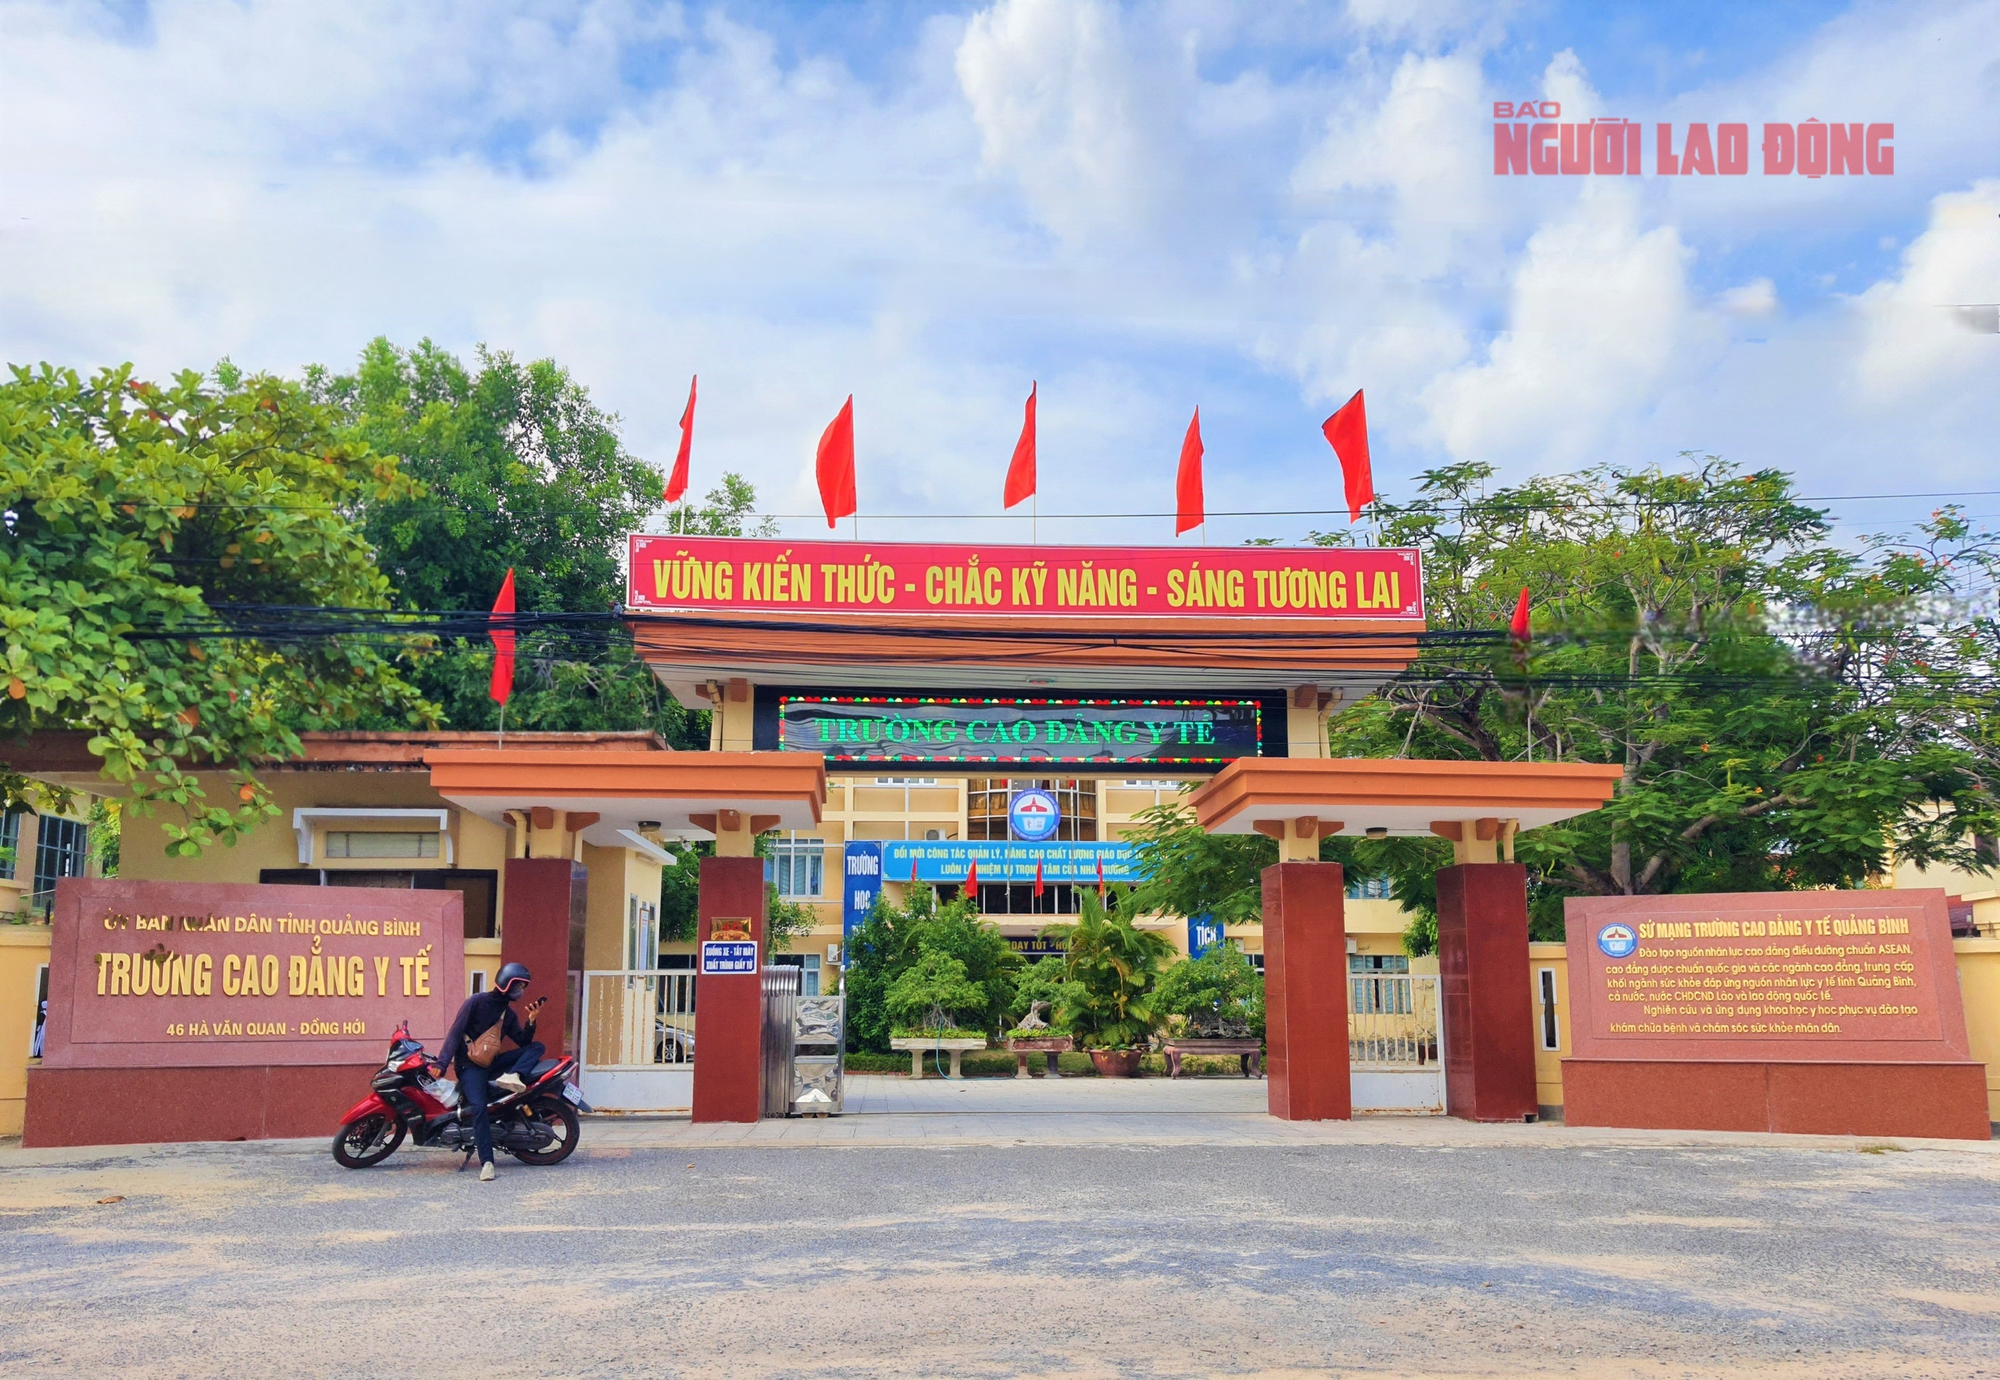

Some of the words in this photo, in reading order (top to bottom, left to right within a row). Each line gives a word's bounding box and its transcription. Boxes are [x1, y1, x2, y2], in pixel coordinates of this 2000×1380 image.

[654, 550, 733, 600] VỮNG
[743, 550, 810, 602] KIẾN
[820, 554, 895, 603] THỨC
[926, 554, 1002, 605] CHẮC
[1012, 561, 1047, 606] KỸ
[1057, 560, 1137, 607] NĂNG
[1167, 563, 1244, 607] SÁNG
[1252, 567, 1347, 609] TƯƠNG
[1357, 571, 1399, 609] LAI
[814, 713, 958, 743] TRƯỜNG
[965, 720, 1037, 744] CAO
[1144, 722, 1167, 744] Y
[910, 846, 924, 859] MỚI
[927, 847, 948, 859] CÔNG
[951, 847, 965, 859] TÁC
[968, 846, 989, 859] QUẢN
[991, 847, 1002, 860] LÝ,
[1029, 849, 1044, 859] CAO
[1047, 846, 1067, 859] CHẤT
[1069, 849, 1094, 861] LƯỢNG
[1096, 848, 1115, 859] GIÁO
[847, 851, 878, 875] TRƯỜNG
[941, 863, 961, 874] LUÔN
[976, 864, 1001, 876] NHIỆM
[1043, 864, 1060, 874] TÂM
[854, 890, 870, 914] HỌC
[136, 914, 174, 931] BAN
[235, 913, 272, 932] DÂN
[277, 912, 315, 934] TỈNH
[319, 914, 378, 935] QUẢNG
[383, 918, 421, 936] BÌNH
[1639, 920, 1655, 938] SỨ
[1657, 922, 1692, 941] MẠNG
[1694, 918, 1739, 938] TRƯỜNG
[1742, 921, 1766, 937] CAO
[1769, 914, 1802, 936] ĐẲNG
[1805, 920, 1812, 935] Y
[1816, 915, 1831, 935] TẾ
[1833, 914, 1876, 936] QUẢNG
[1878, 916, 1909, 935] BÌNH
[1639, 948, 1658, 958] Đào
[1660, 948, 1674, 959] tạo
[1676, 946, 1704, 959] nguồn
[1706, 947, 1728, 956] nhân
[1728, 947, 1743, 958] lực
[1745, 948, 1763, 956] cao
[1814, 944, 1844, 957] dưỡng
[1846, 942, 1876, 954] chuẩn
[1879, 944, 1913, 955] ASEAN,
[222, 954, 279, 996] CAO
[288, 935, 364, 996] ĐẲNG
[374, 957, 390, 996] Y
[400, 944, 432, 996] TẾ
[1606, 966, 1623, 974] cao
[1625, 961, 1649, 976] đẳng
[1676, 961, 1704, 974] chuẩn
[1706, 962, 1729, 975] quốc
[1732, 964, 1746, 975] gia
[1749, 963, 1760, 972] và
[1762, 963, 1780, 972] các
[1783, 962, 1812, 975] ngành
[1814, 964, 1833, 972] cao
[1864, 962, 1890, 974] trung
[1894, 960, 1914, 972] cấp
[1607, 977, 1626, 988] khối
[1629, 978, 1658, 990] ngành
[1660, 978, 1675, 988] sức
[1678, 976, 1701, 988] khỏe
[1703, 978, 1722, 989] đáp
[1724, 978, 1741, 989] ứng
[1743, 976, 1772, 989] nguồn
[1774, 977, 1798, 987] nhân
[1800, 977, 1815, 989] lực
[1817, 979, 1823, 988] y
[1826, 975, 1836, 986] tế
[1837, 976, 1855, 986] tỉnh
[1857, 975, 1891, 989] Quảng
[1893, 976, 1916, 987] Bình,
[1608, 990, 1620, 1001] cả
[1623, 991, 1647, 1002] nước,
[1650, 991, 1672, 1001] nước
[1675, 991, 1714, 1001] CHDCND
[1717, 991, 1733, 1001] Lào
[1736, 991, 1747, 1000] và
[1749, 992, 1764, 1000] lao
[1766, 990, 1791, 1003] động
[1793, 990, 1818, 1002] quốc
[1820, 989, 1833, 1000] tế.
[1644, 1005, 1677, 1017] Nghiên
[1680, 1005, 1697, 1015] cứu
[1701, 1005, 1712, 1015] và
[1716, 1005, 1734, 1017] ứng
[1737, 1005, 1762, 1017] dụng
[1764, 1005, 1789, 1015] khoa
[1790, 1005, 1808, 1016] học
[1810, 1007, 1816, 1017] y
[1839, 1005, 1863, 1016] phục
[1865, 1006, 1877, 1016] vụ
[1879, 1004, 1899, 1015] đào
[1901, 1004, 1918, 1016] tạo
[166, 1024, 184, 1036] 46
[189, 1020, 209, 1036] HÀ
[213, 1020, 242, 1036] VĂN
[246, 1023, 286, 1036] QUAN
[300, 1018, 339, 1035] ĐỒNG
[343, 1019, 365, 1034] HỚI
[1610, 1022, 1636, 1033] khám
[1638, 1022, 1662, 1033] chữa
[1664, 1022, 1687, 1034] bệnh
[1690, 1022, 1700, 1033] và
[1702, 1022, 1729, 1033] chăm
[1731, 1022, 1749, 1033] sóc
[1751, 1022, 1767, 1033] sức
[1769, 1021, 1793, 1033] khỏe
[1795, 1022, 1819, 1033] nhân
[1821, 1022, 1842, 1033] dân.
